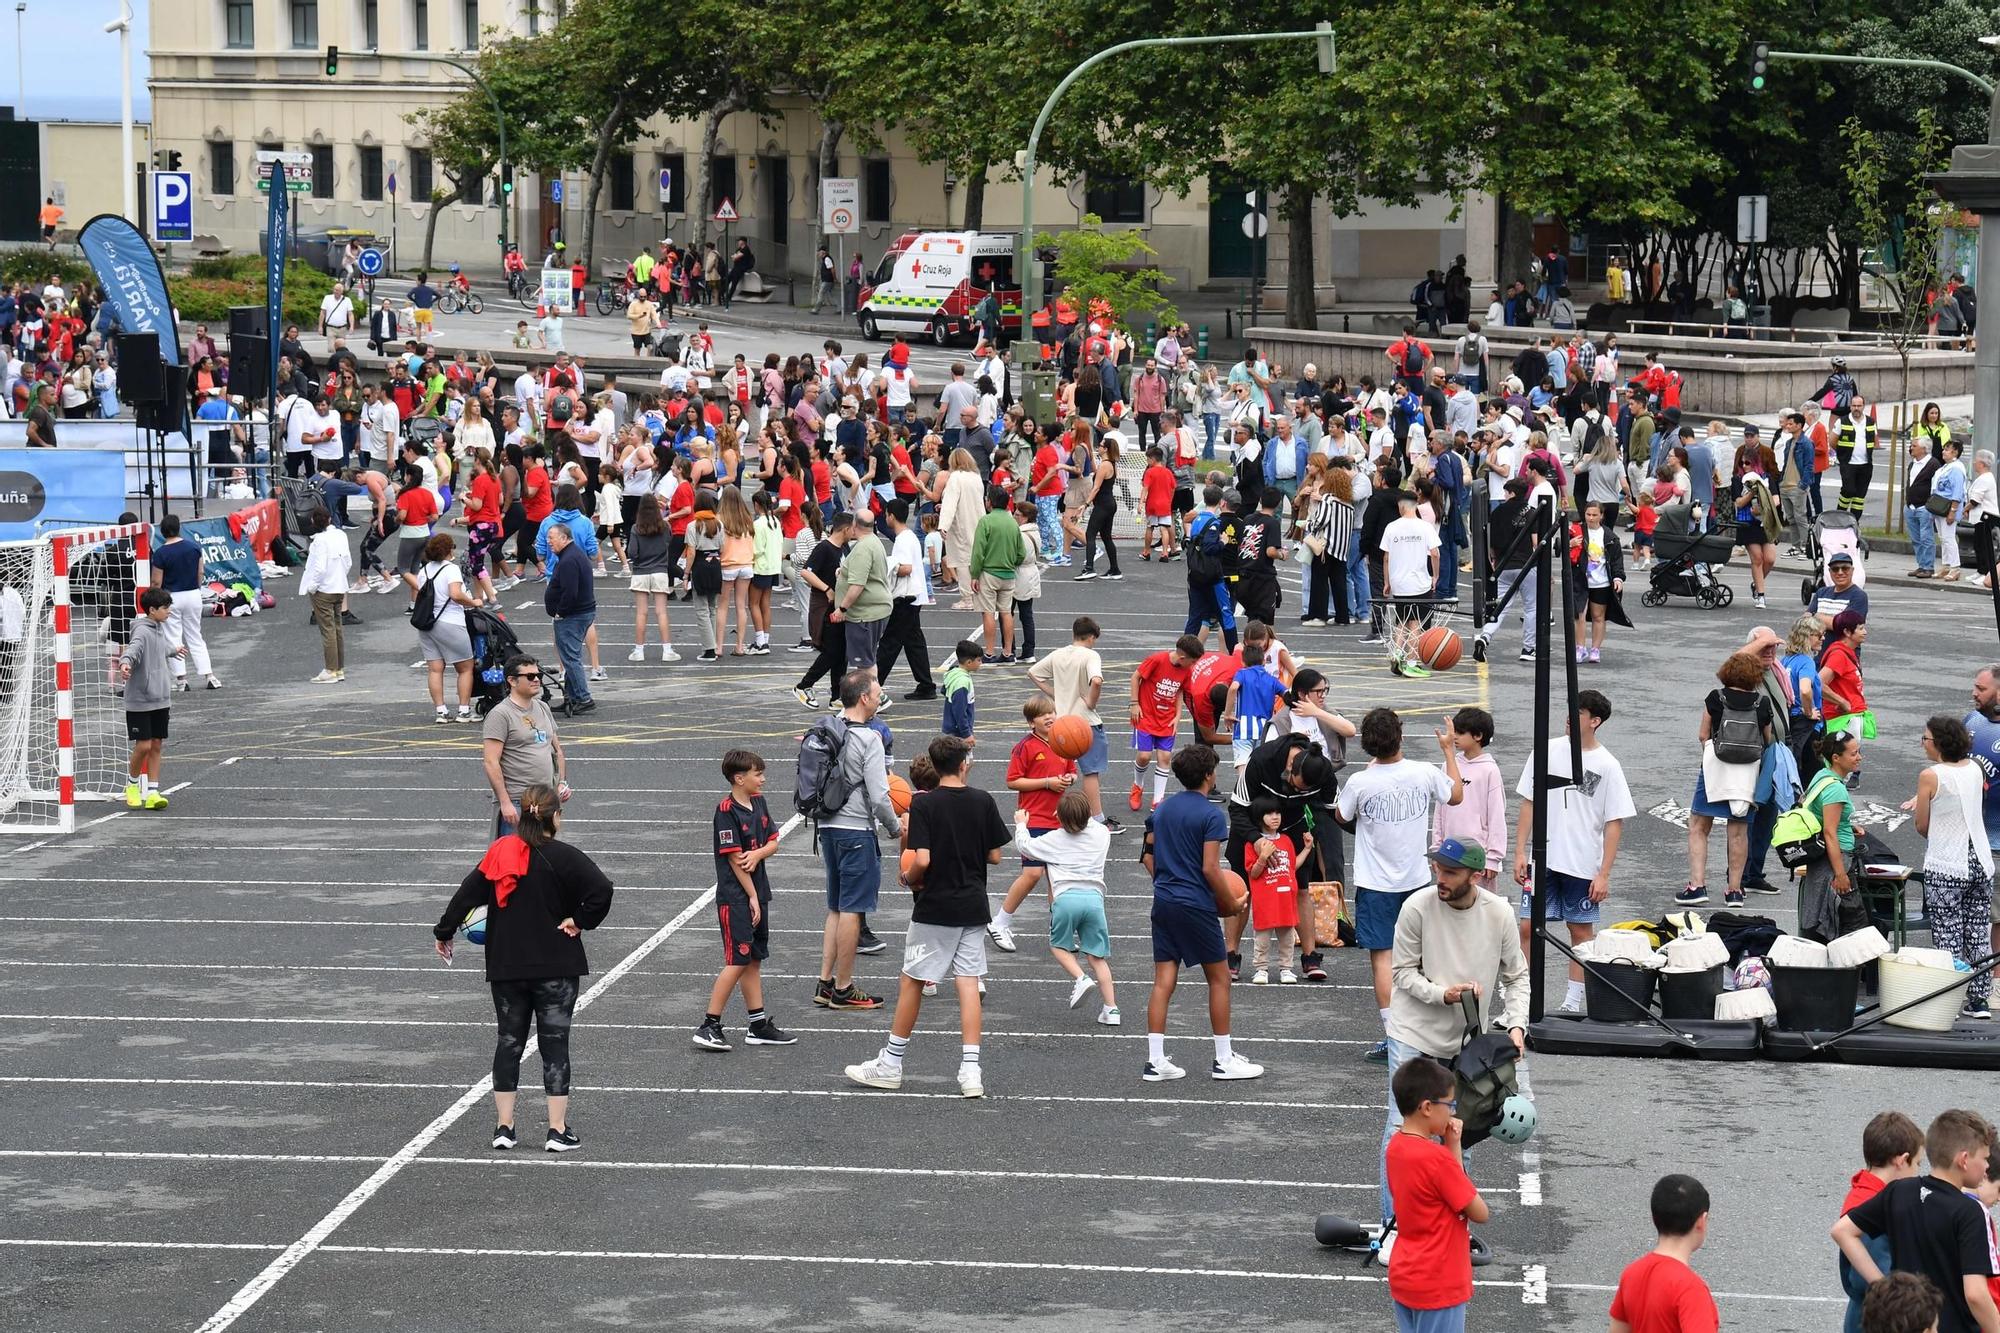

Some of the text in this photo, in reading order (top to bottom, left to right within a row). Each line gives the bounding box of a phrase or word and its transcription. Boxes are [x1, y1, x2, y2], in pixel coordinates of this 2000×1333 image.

[158, 175, 188, 220] P
[836, 215, 847, 223] 50
[922, 264, 952, 278] Cruz Roja
[1156, 682, 1179, 691] DEPORT
[1522, 894, 1529, 908] 3
